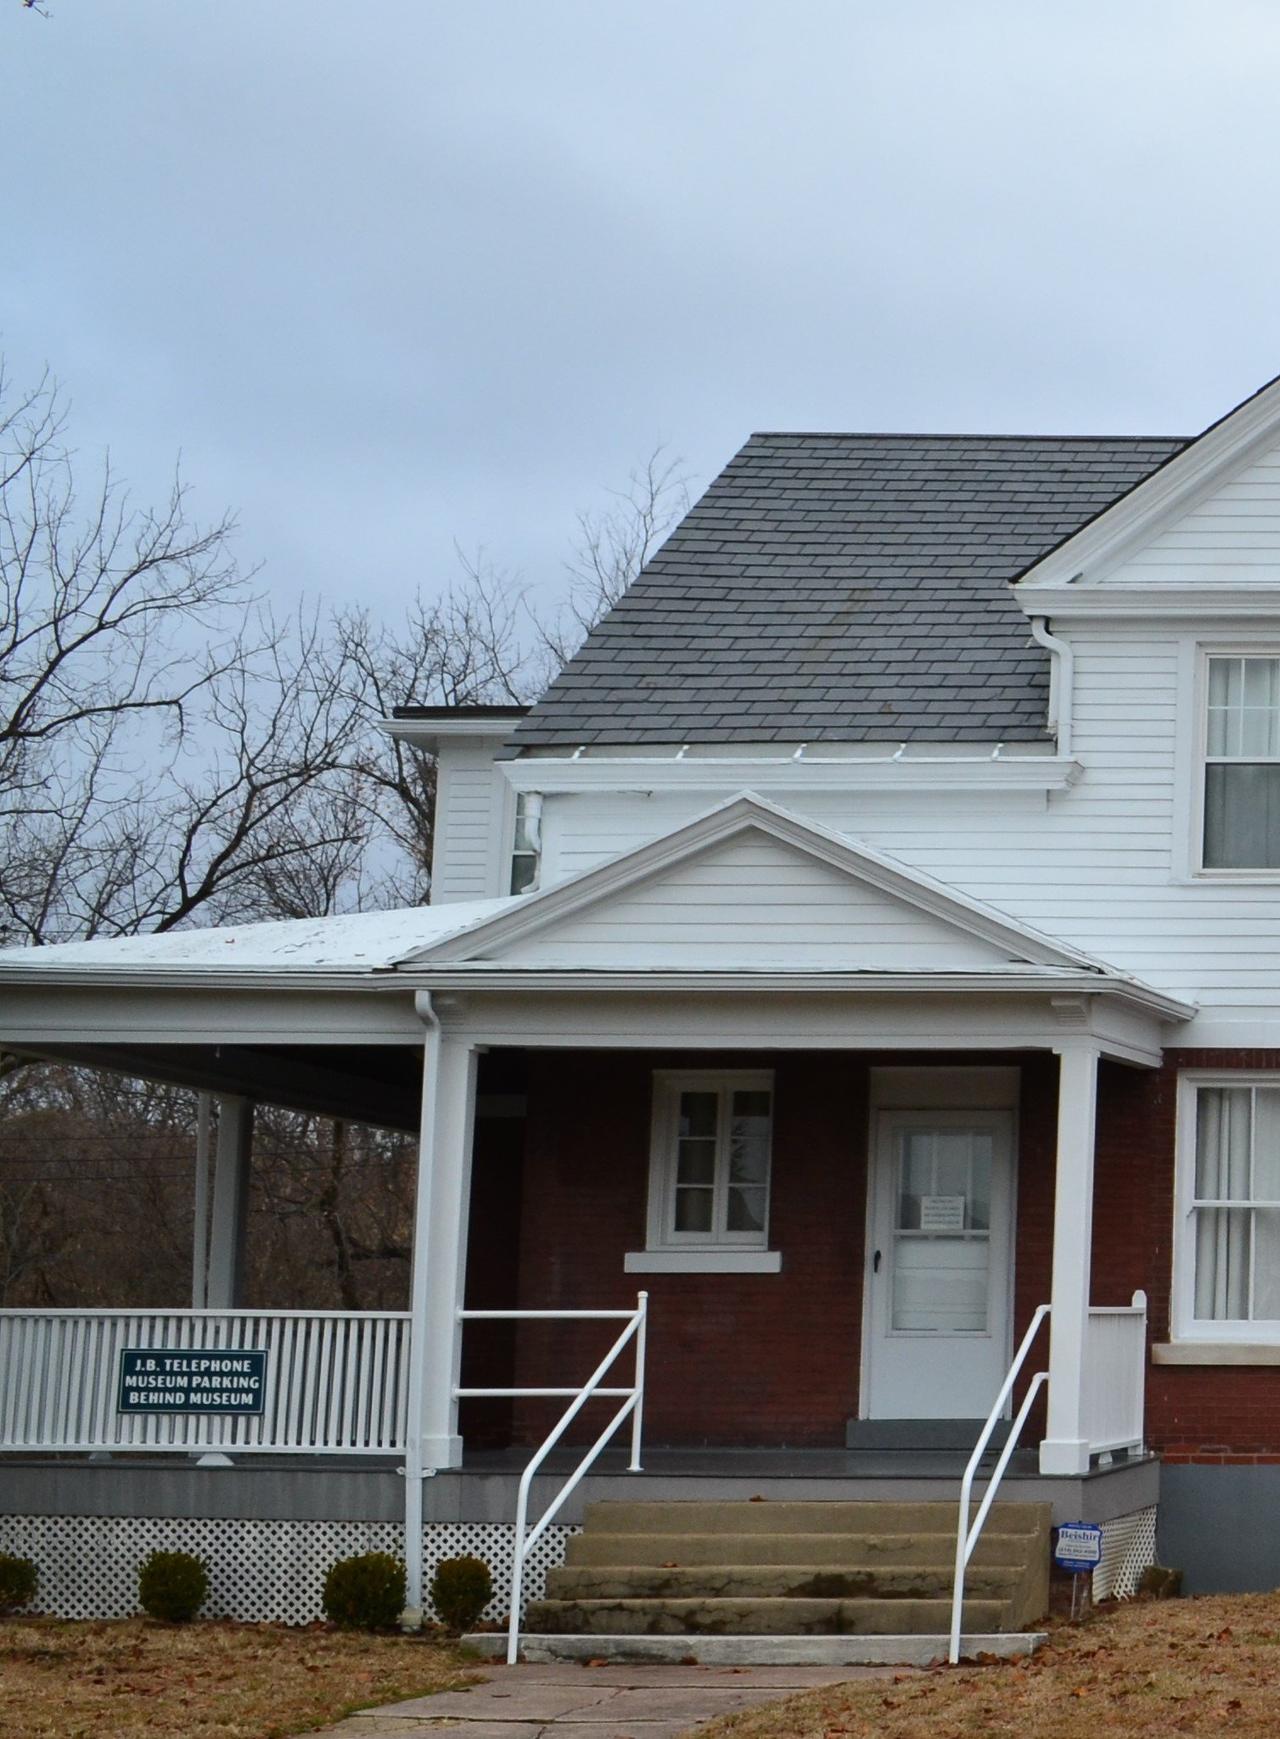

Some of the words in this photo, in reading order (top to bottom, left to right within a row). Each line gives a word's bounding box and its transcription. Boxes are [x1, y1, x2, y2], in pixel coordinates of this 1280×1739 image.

[135, 1359, 160, 1371] J.B.
[165, 1360, 252, 1372] TELEPHONE
[125, 1375, 188, 1388] MUSEUM
[192, 1377, 259, 1389] PARKING
[129, 1391, 185, 1404] BEHIND
[189, 1392, 253, 1405] MUSEUM
